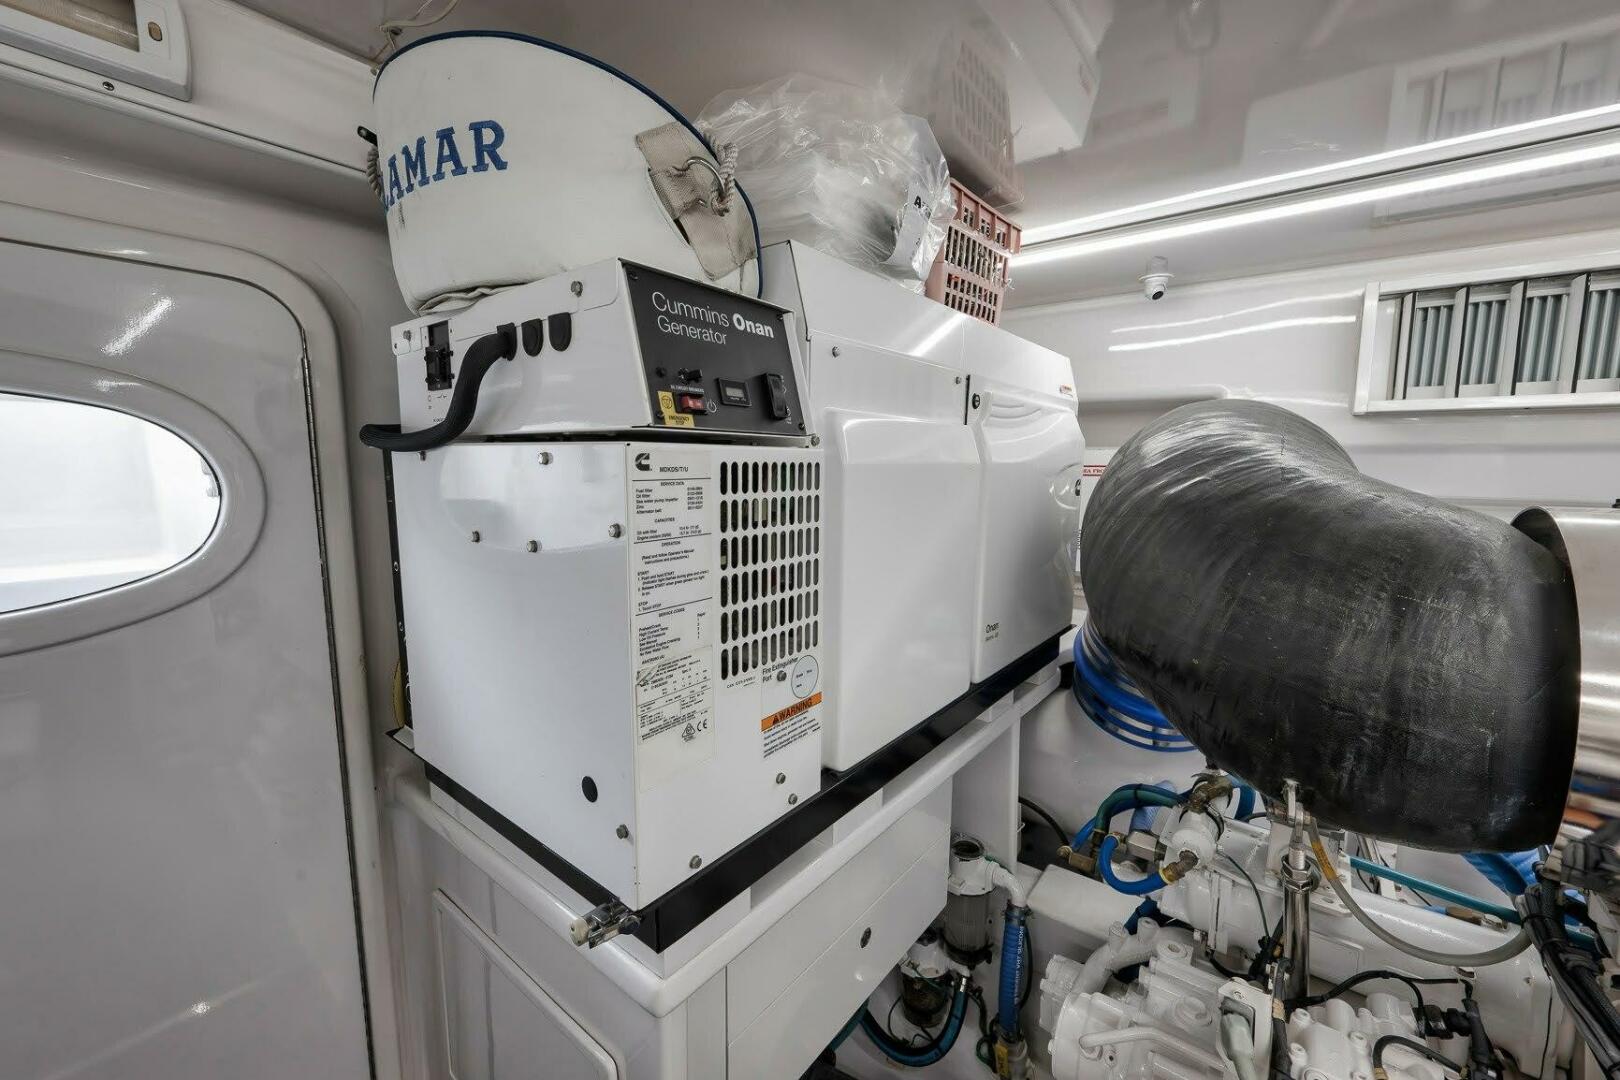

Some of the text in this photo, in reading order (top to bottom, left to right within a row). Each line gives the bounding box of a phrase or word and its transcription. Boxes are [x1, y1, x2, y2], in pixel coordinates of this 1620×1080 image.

[652, 291, 775, 339] Cummins Onan
[657, 315, 727, 345] Generator
[762, 657, 799, 675] Fire Extinguisher
[762, 674, 772, 683] Port
[779, 697, 813, 721] WARNING
